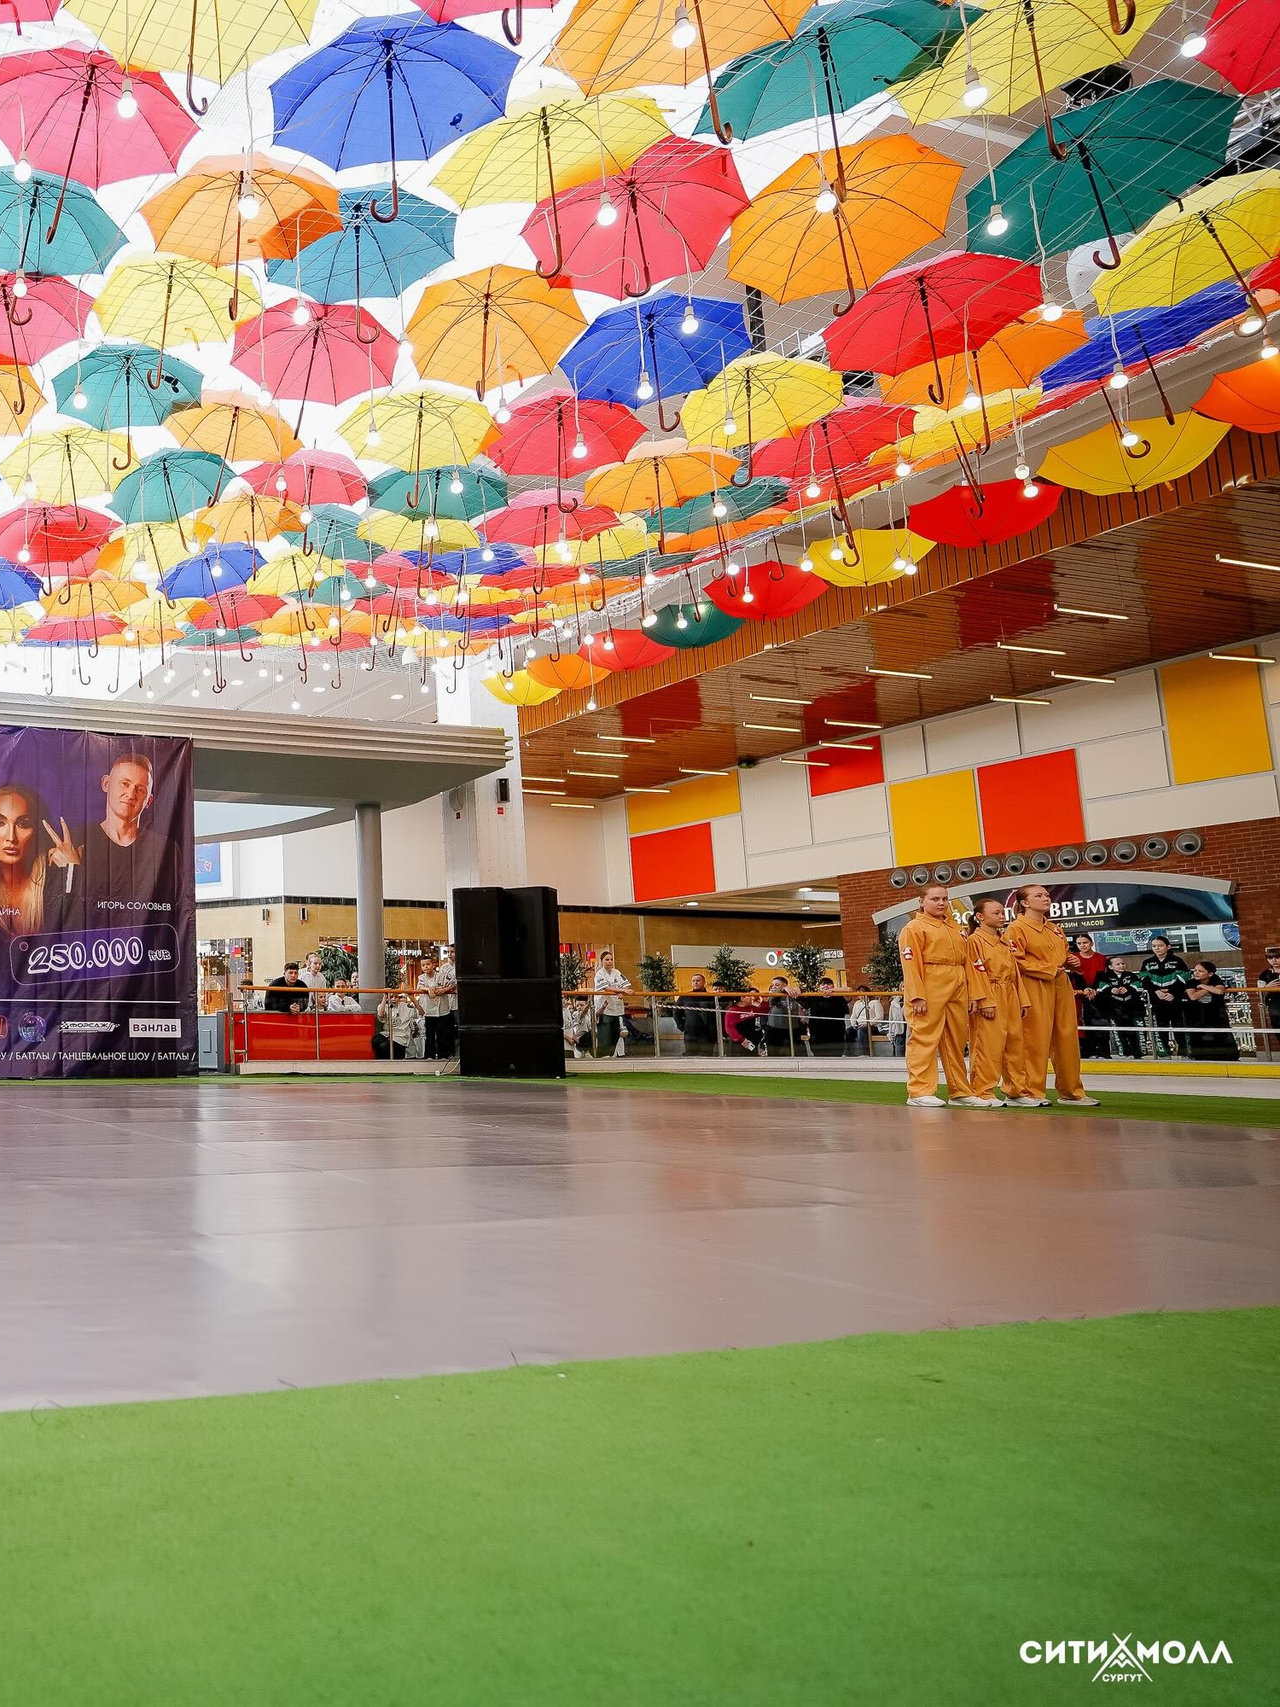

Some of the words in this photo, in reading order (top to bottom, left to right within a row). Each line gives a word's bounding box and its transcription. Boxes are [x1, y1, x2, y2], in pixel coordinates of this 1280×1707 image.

[97, 901, 125, 909] ИГОРЬ
[126, 901, 171, 911] СОЛОВЬЕВ
[1050, 897, 1119, 918] ВРЕМЯ
[27, 936, 144, 975] 250.000
[148, 950, 172, 962] RUB
[15, 1052, 50, 1060] БАТТЛЫ
[58, 1052, 127, 1062] ТАНЦЕВАЛЬНОЕ
[128, 1052, 150, 1061] ШОУ
[157, 1052, 190, 1061] БАТТЛЫ
